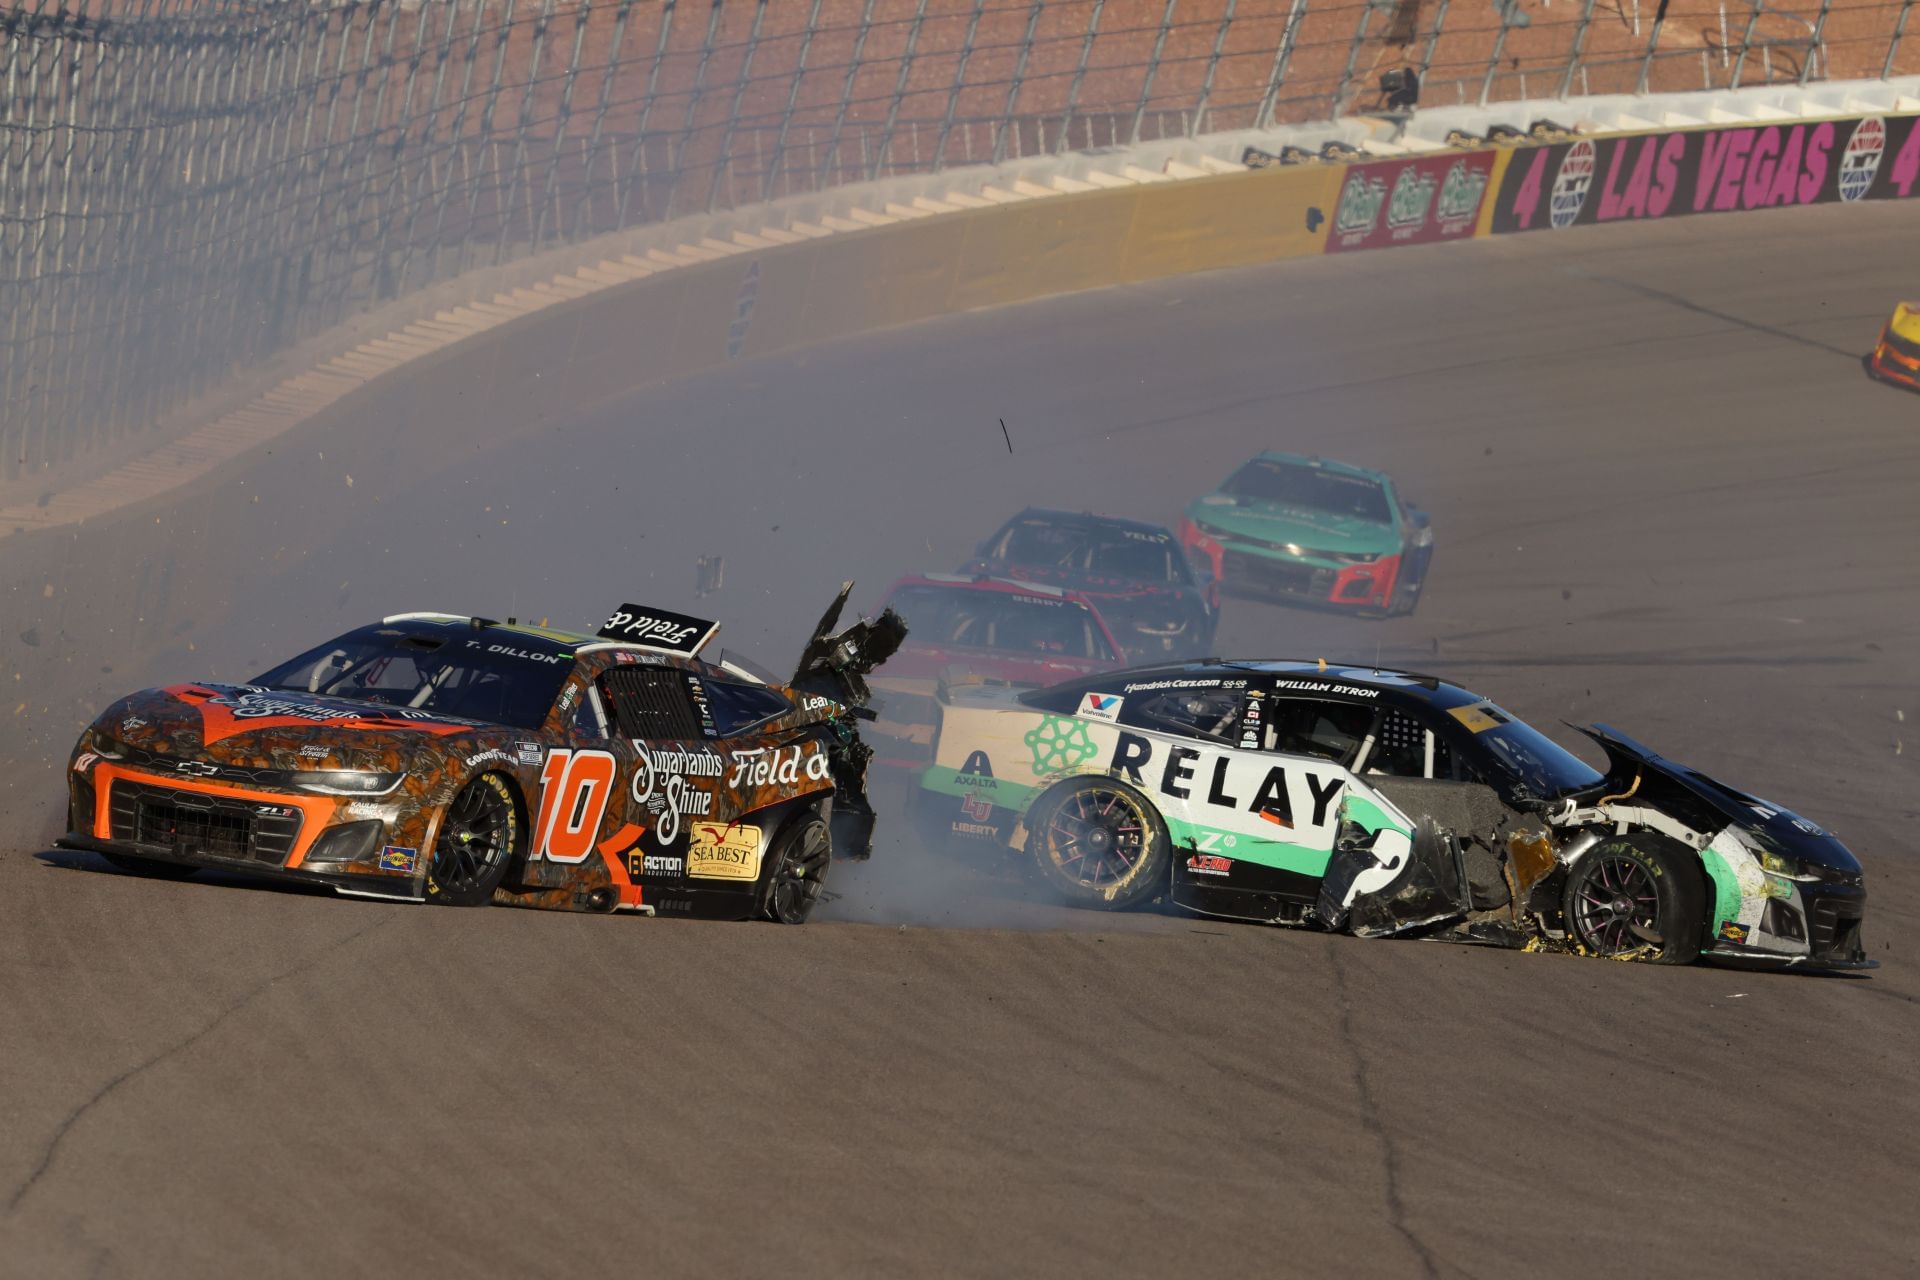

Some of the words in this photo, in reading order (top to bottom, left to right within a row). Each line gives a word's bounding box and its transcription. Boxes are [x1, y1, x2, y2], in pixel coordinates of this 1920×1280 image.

[1512, 146, 1549, 230] 4
[1597, 132, 1686, 221] LAS
[1693, 121, 1836, 212] VEGAS
[1012, 595, 1064, 608] BERRY
[624, 616, 698, 644] Field
[466, 640, 481, 649] T.
[488, 644, 560, 664] DILLON
[1275, 679, 1331, 693] WILLIAM
[1331, 684, 1380, 698] BYRON
[1082, 707, 1113, 719] Valvoline
[73, 752, 99, 772] 10
[466, 749, 519, 767] GOODYEAR
[729, 745, 800, 788] Field
[632, 739, 723, 804] Sugarlands
[1110, 730, 1345, 830] RELAY
[954, 775, 998, 789] AXALTA
[255, 806, 293, 817] ZL1
[529, 747, 617, 863] 10
[656, 775, 712, 846] Shine
[961, 792, 992, 822] LU
[952, 821, 999, 836] LIBERTY
[1197, 831, 1224, 852] Z
[383, 854, 415, 865] SUNOCO
[643, 855, 682, 872] ACTION
[693, 845, 714, 862] SEA
[716, 846, 751, 865] BEST
[1721, 928, 1748, 938] SUNOCO
